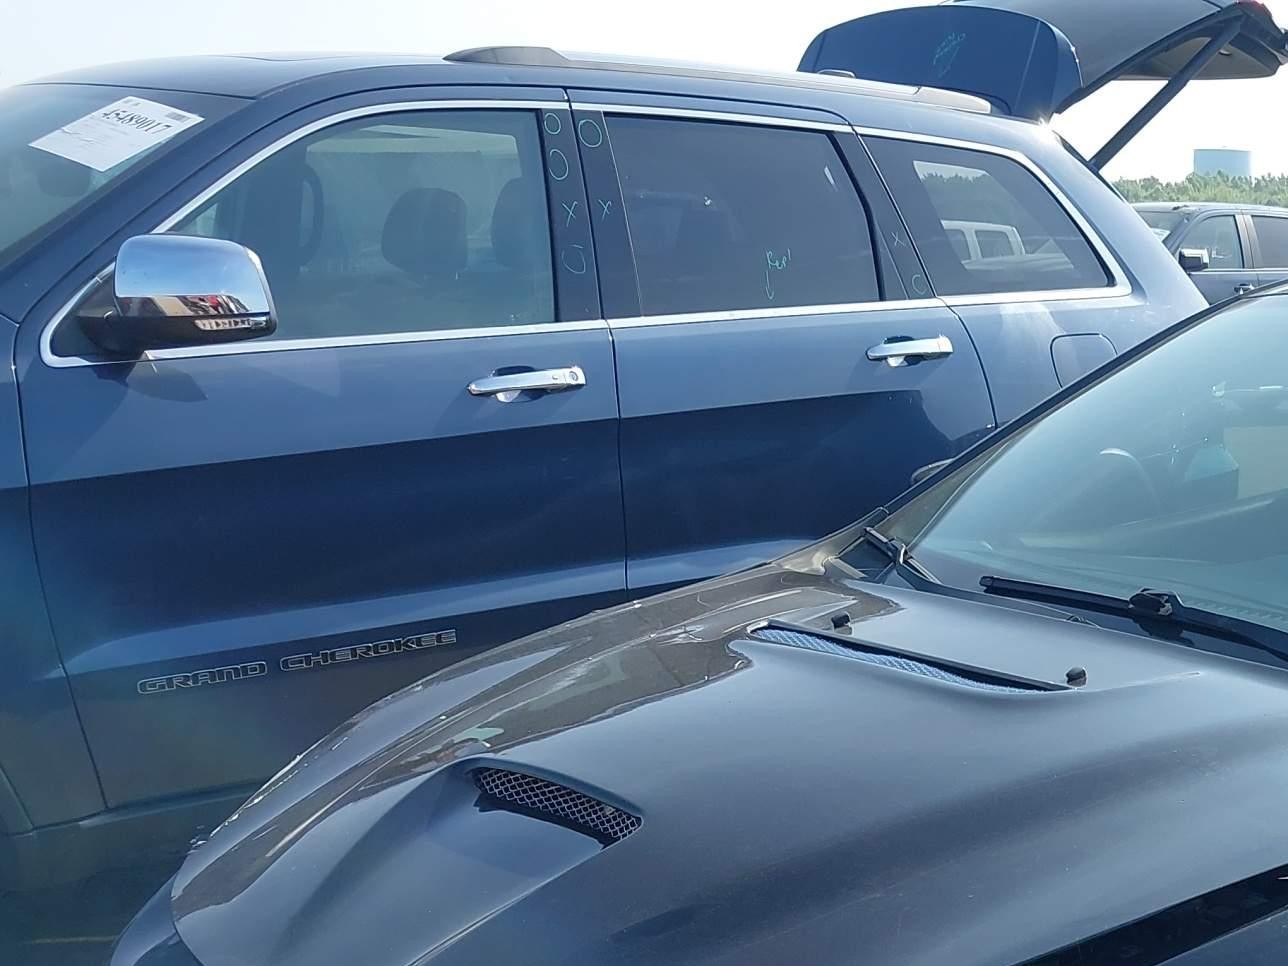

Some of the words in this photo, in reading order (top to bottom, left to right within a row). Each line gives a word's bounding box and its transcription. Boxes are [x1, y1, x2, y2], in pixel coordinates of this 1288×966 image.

[101, 107, 172, 135] 45489017
[137, 661, 268, 694] GRAND
[280, 629, 457, 672] CHEROKEE
